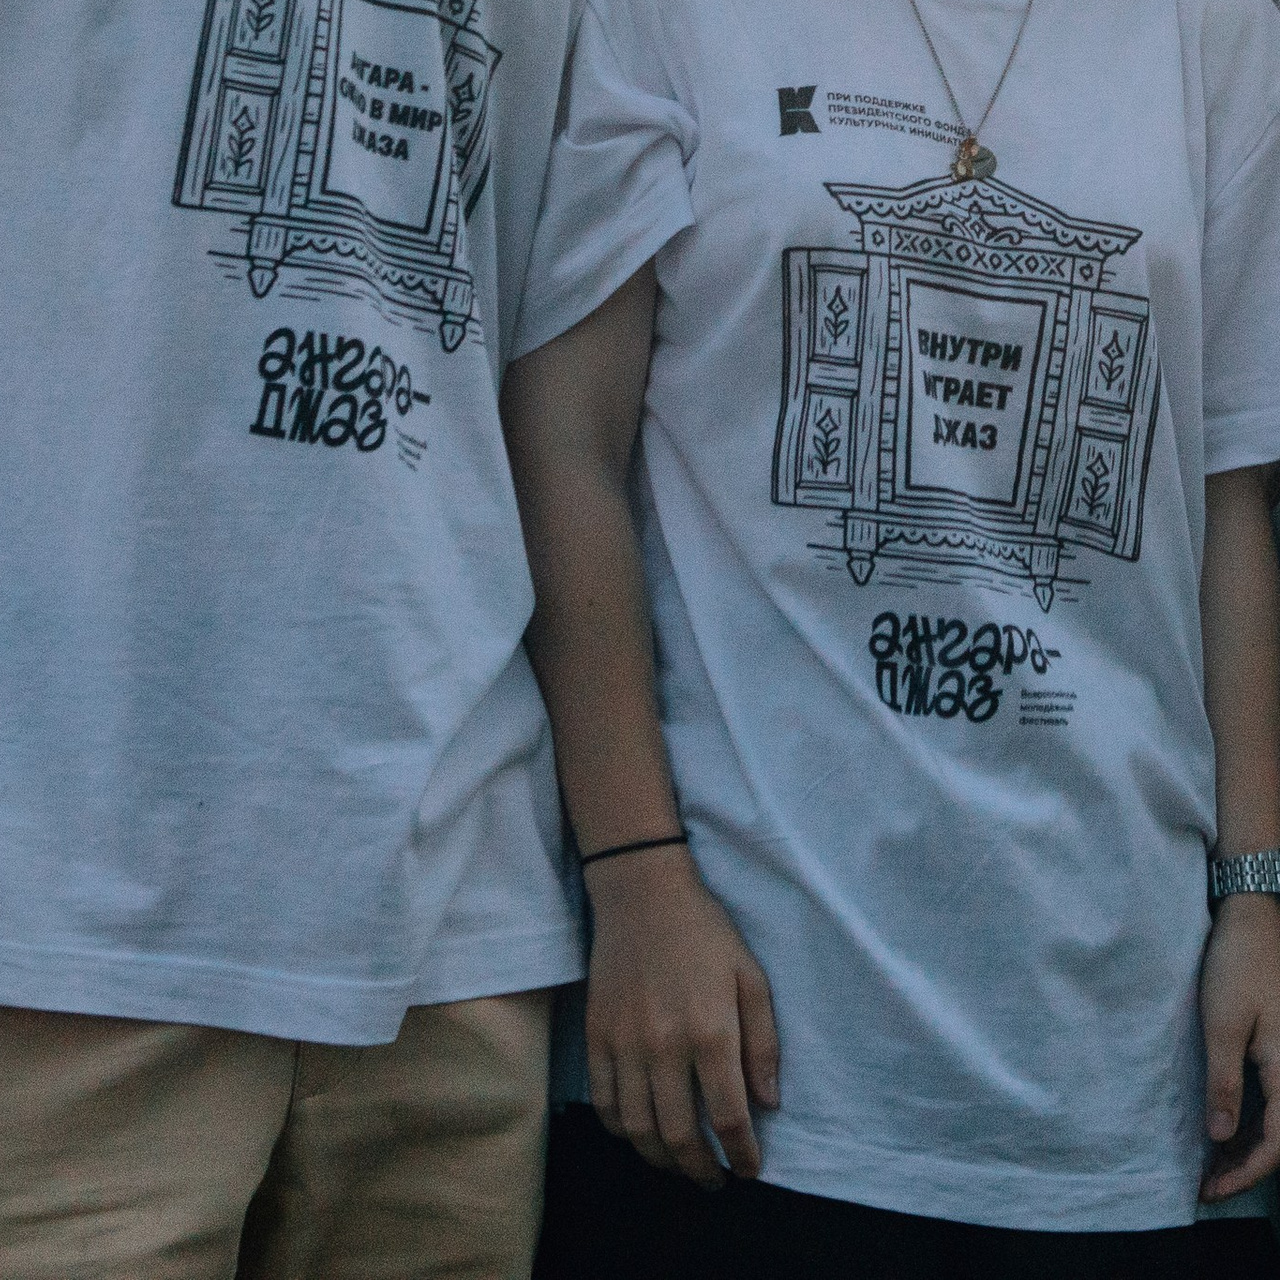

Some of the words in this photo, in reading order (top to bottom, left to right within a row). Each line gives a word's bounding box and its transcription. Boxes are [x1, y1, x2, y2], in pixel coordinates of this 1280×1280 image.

[369, 98, 384, 120] В
[388, 102, 442, 132] МИР
[827, 92, 851, 103] ПРИ
[855, 94, 926, 114] ПОДДЕРЖКЕ
[828, 104, 931, 128] ПРЕЗИДЕНТСКОГО
[934, 121, 974, 137] ФОНДА
[829, 117, 906, 133] КУЛЬТУРНЫХ
[910, 126, 966, 148] ИНИЦИАТИ
[918, 328, 1023, 371] ВНУТРИ
